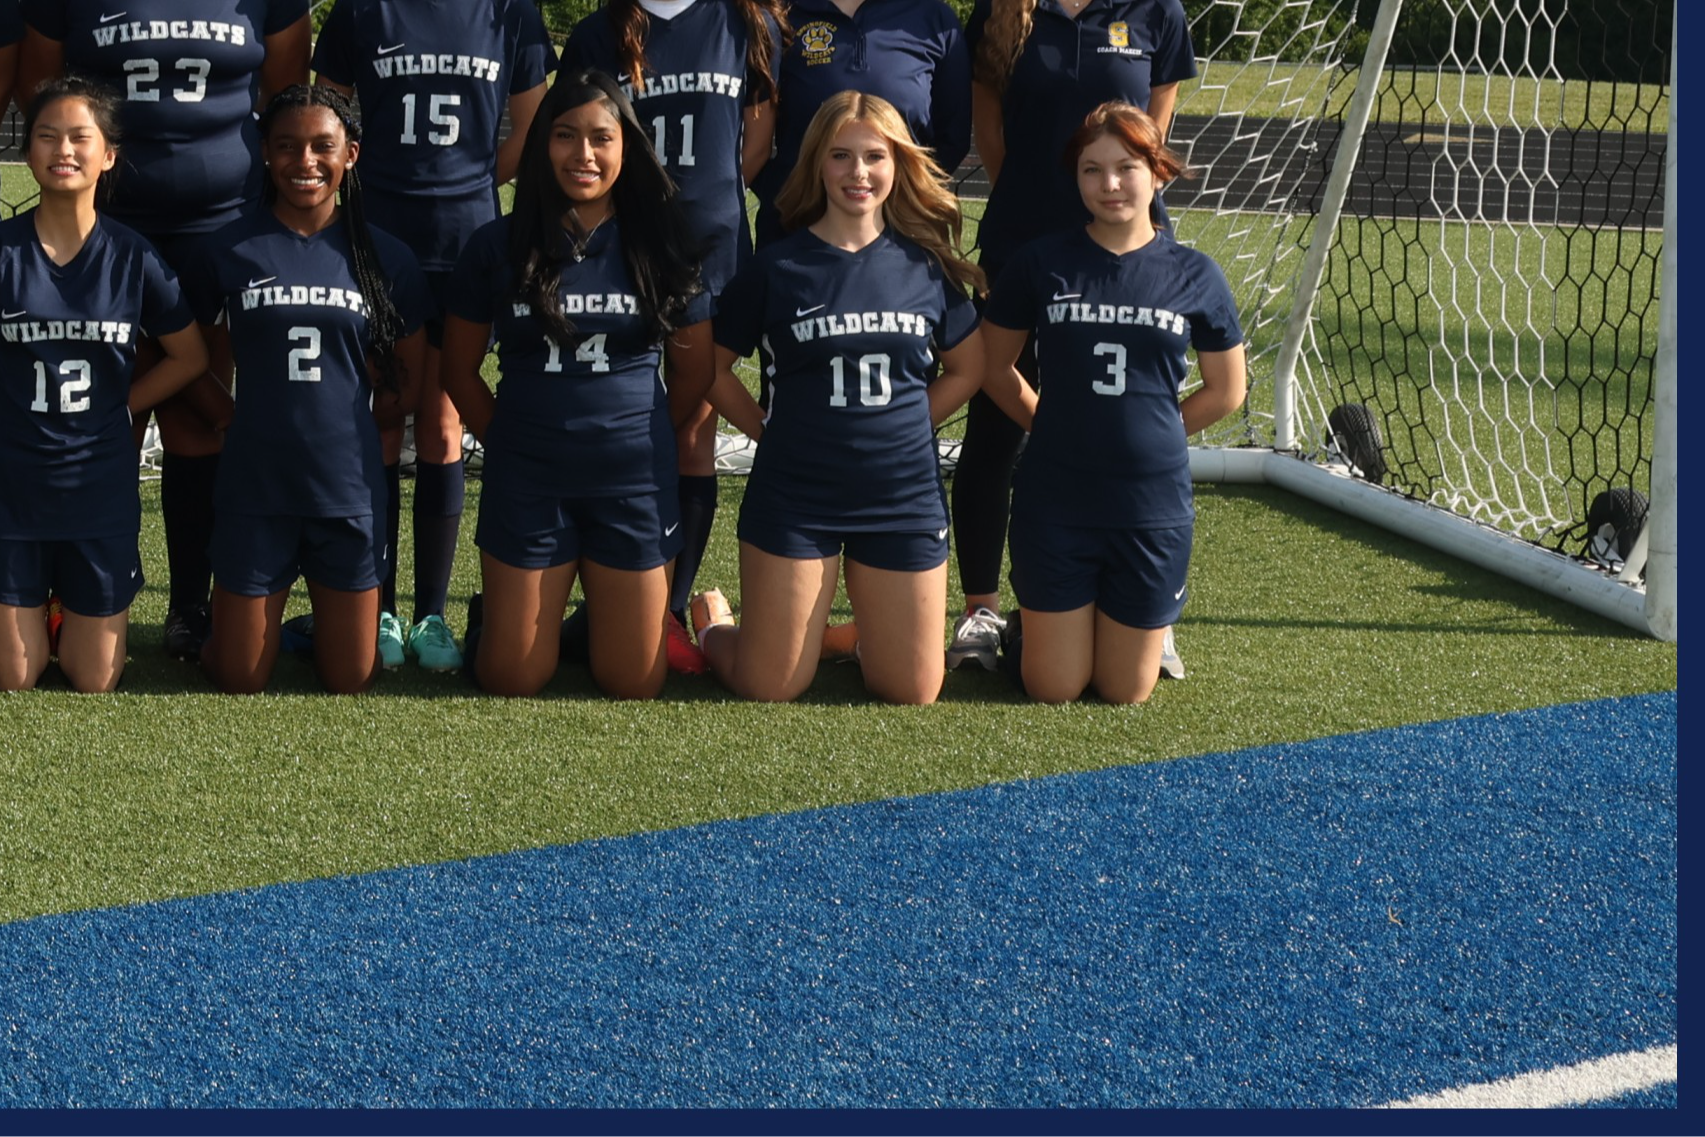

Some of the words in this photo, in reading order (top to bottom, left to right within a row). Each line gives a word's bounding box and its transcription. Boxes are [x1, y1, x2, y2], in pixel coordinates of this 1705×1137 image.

[92, 20, 246, 48] WILDCATS
[1108, 21, 1129, 48] S
[123, 57, 211, 103] 23
[374, 52, 501, 83] WILDCATS
[400, 93, 461, 146] 15
[652, 114, 696, 167] 11
[1, 320, 132, 345] WILDCATS
[791, 310, 927, 343] WILDCATS
[1046, 301, 1185, 336] WILDCATS
[287, 326, 322, 382] 2
[544, 333, 610, 373] 14
[1092, 341, 1127, 396] 3
[30, 359, 92, 413] 12
[829, 353, 892, 407] 10
